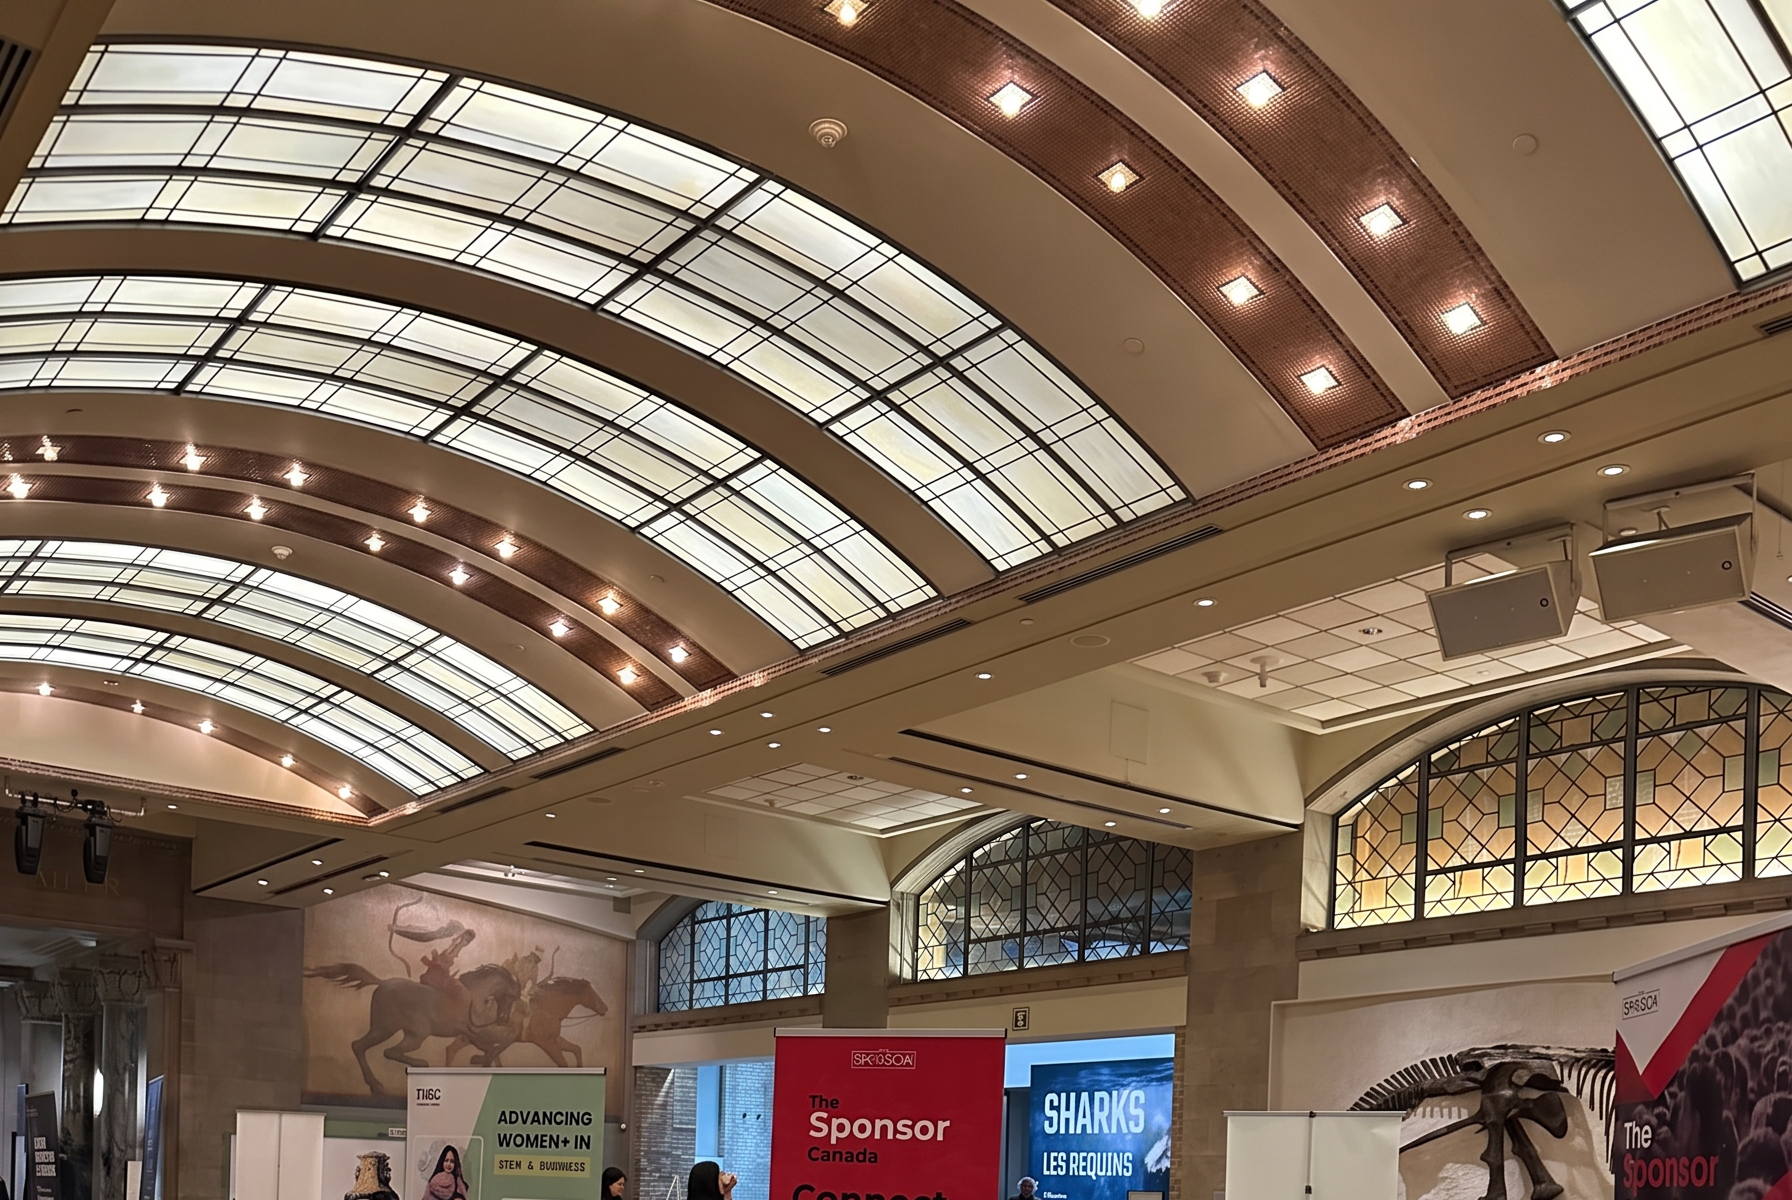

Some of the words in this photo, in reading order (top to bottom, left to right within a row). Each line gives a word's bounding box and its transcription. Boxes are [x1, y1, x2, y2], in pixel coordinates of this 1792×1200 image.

[809, 1094, 840, 1109] The
[1044, 1089, 1145, 1134] SHARKS
[497, 1110, 593, 1126] ADVANCING
[809, 1111, 950, 1144] Sponsor
[497, 1133, 570, 1148] WOMEN+
[573, 1135, 591, 1150] IN
[1624, 1121, 1652, 1149] The
[498, 1160, 522, 1170] STEM
[527, 1160, 534, 1170] &
[807, 1146, 878, 1163] Canada
[1043, 1152, 1066, 1175] LES
[1069, 1152, 1132, 1180] REQUINS
[1623, 1152, 1719, 1197] Sponsor
